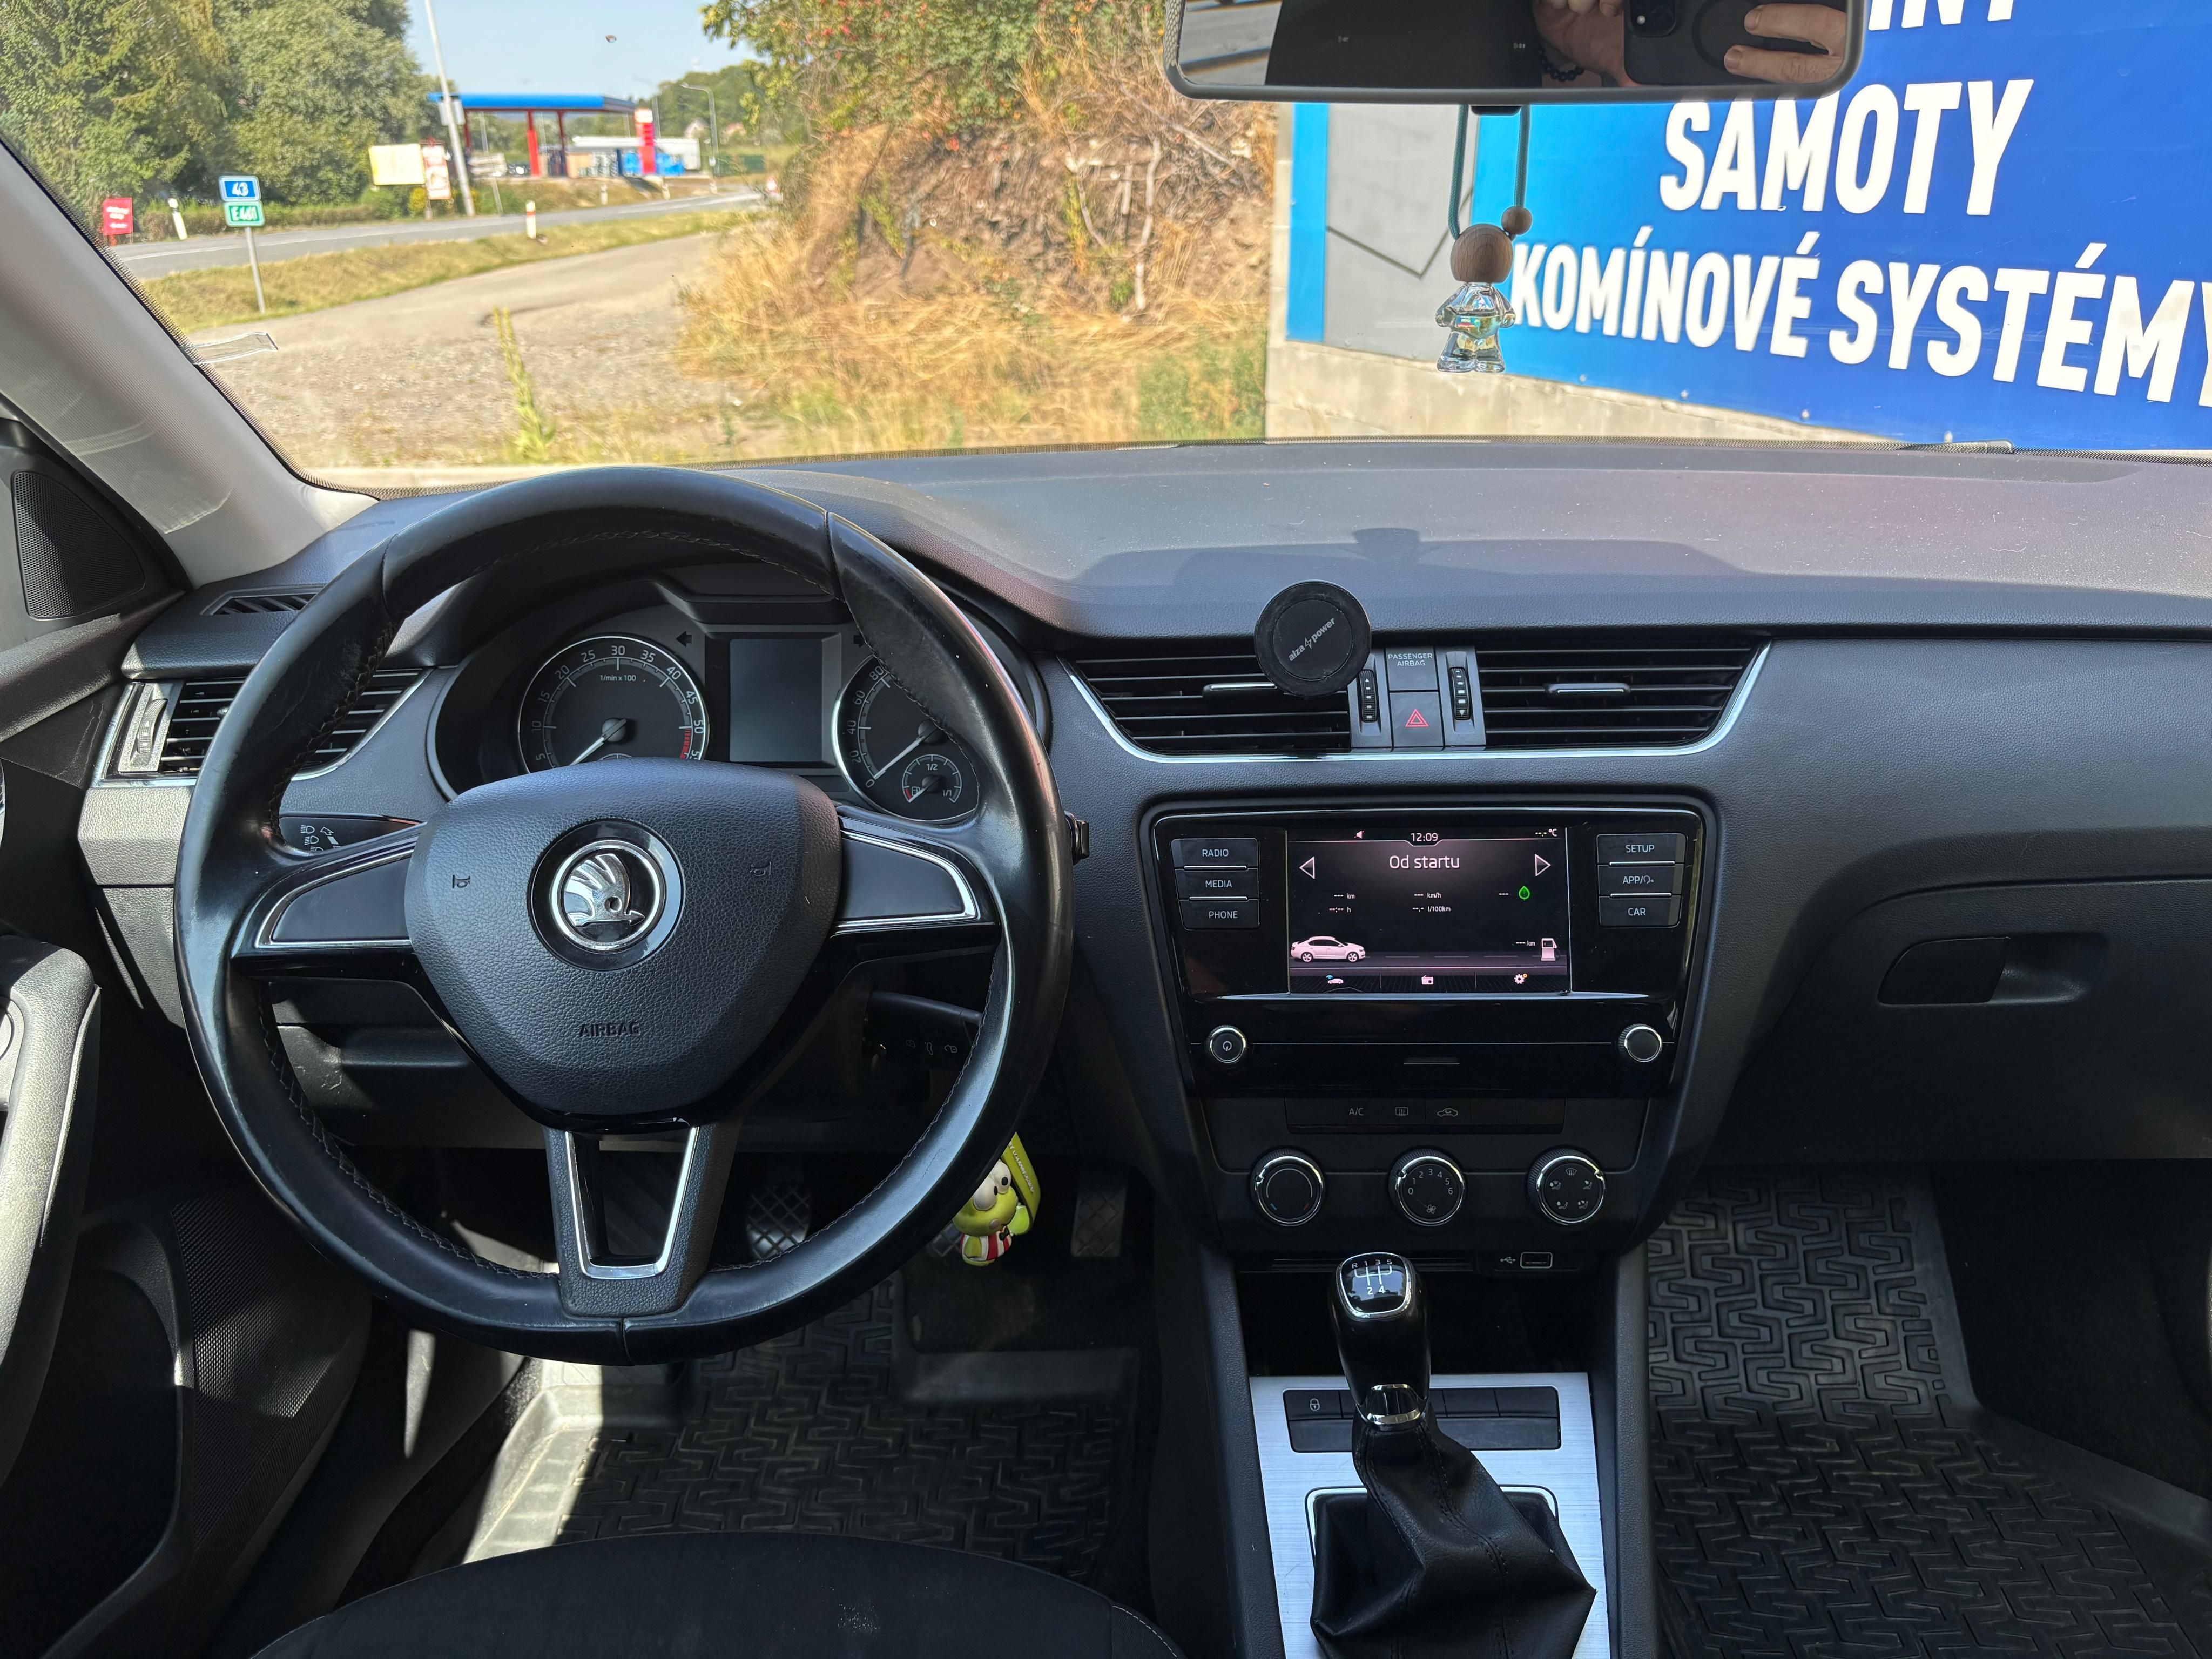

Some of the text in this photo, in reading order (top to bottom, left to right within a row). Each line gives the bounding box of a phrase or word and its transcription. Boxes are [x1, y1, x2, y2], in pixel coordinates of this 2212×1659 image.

[1511, 226, 1820, 358] KOMÍNOVÉ
[1289, 617, 1336, 662] alza power
[581, 649, 595, 662] 25
[611, 645, 625, 656] 30
[640, 650, 655, 663] 35
[555, 665, 570, 679] 20
[666, 666, 681, 680] 40
[869, 665, 885, 682] 80
[685, 690, 698, 704] 45
[854, 690, 865, 705] 60
[693, 719, 704, 734] 50
[846, 720, 856, 734] 40
[849, 750, 861, 763] 20
[865, 779, 874, 787] 0
[1411, 832, 1438, 841] 12:09
[1625, 845, 1654, 853] SETUP
[1389, 855, 1459, 868] Od startu
[1622, 875, 1643, 884] APP/
[1628, 907, 1645, 915] CAR
[579, 1022, 640, 1037] AIRBAG
[1378, 1285, 1385, 1293] 4
